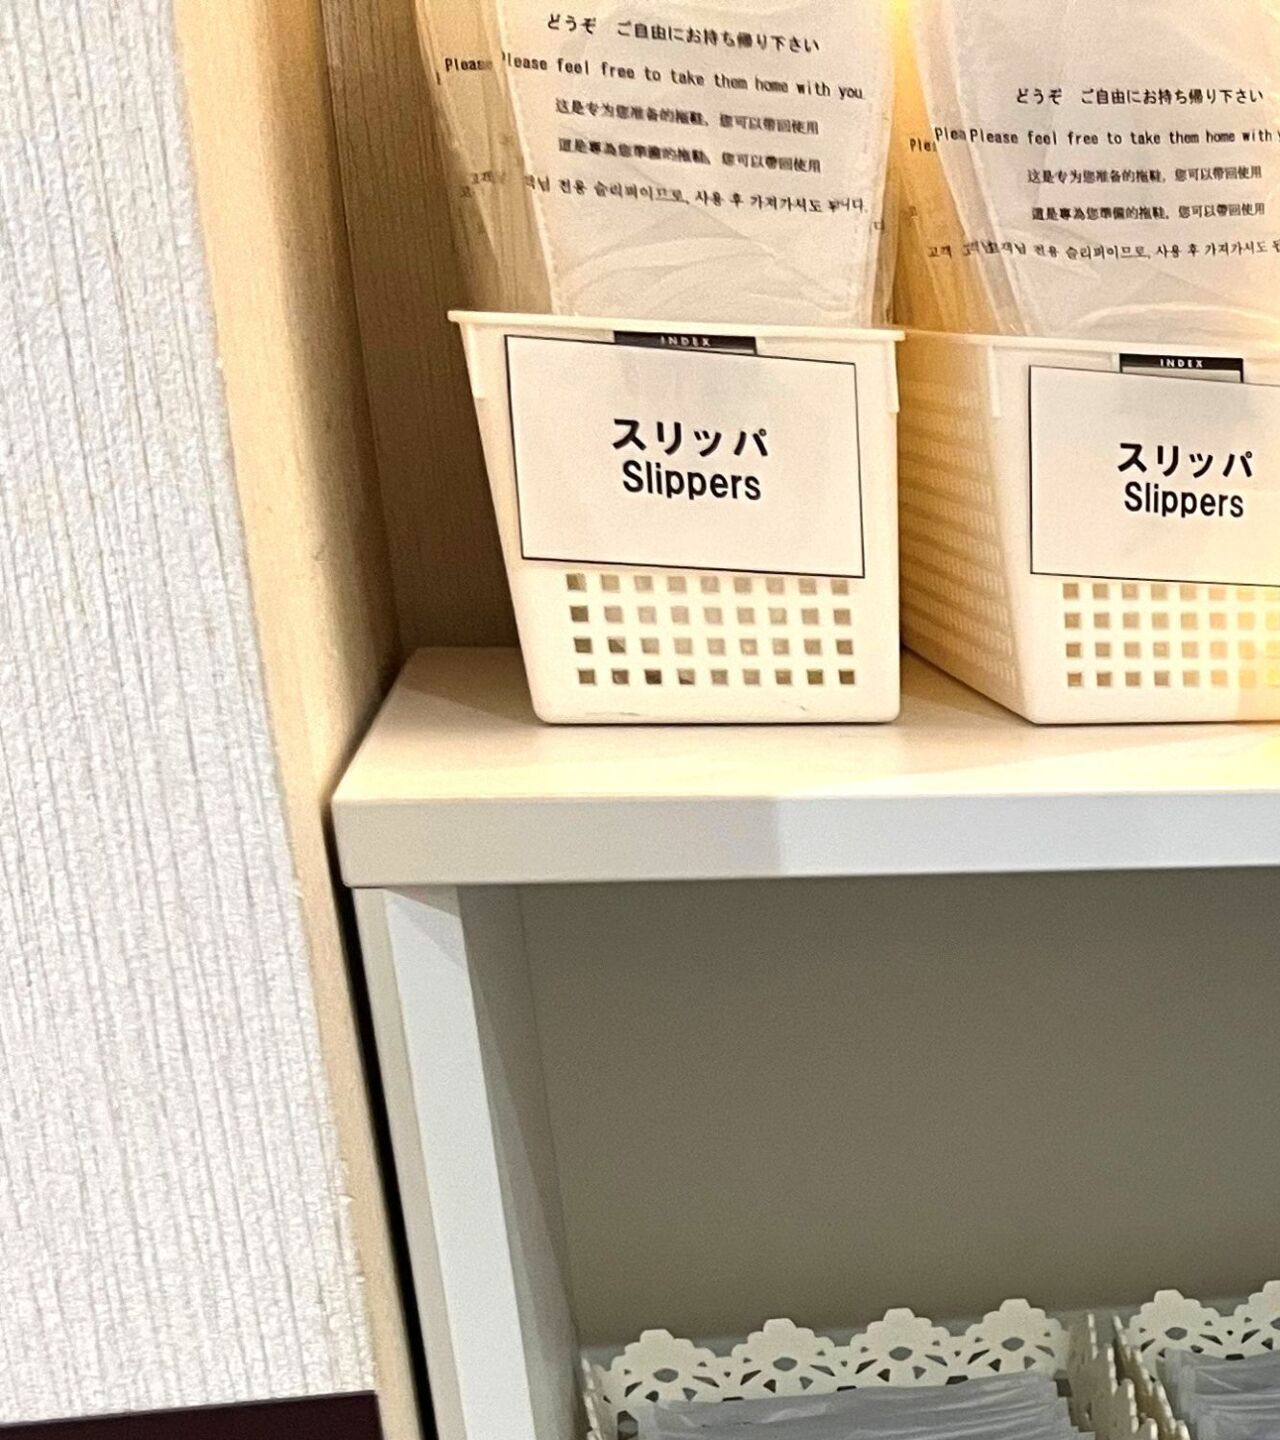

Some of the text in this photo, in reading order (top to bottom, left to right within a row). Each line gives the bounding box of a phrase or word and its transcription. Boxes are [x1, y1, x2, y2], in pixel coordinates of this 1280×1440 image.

[548, 13, 596, 34] どうぞ
[558, 58, 589, 74] feel
[602, 61, 635, 79] free
[646, 66, 660, 81] to
[671, 69, 704, 86] take
[715, 74, 748, 90] them
[755, 75, 788, 93] home
[797, 81, 830, 97] with
[839, 87, 863, 99] you
[1017, 88, 1263, 105] どうぞ ご自由にお持ち帰り下さい
[970, 128, 1018, 144] Please
[1028, 131, 1056, 145] feel
[1068, 132, 1098, 145] free
[1107, 132, 1122, 145] to
[1131, 131, 1160, 145] take
[1170, 131, 1199, 144] them
[1206, 131, 1235, 143] home
[1243, 129, 1272, 141] with
[661, 336, 711, 347] INDEX
[1160, 358, 1203, 368] INDEX
[613, 418, 768, 458] スリッパ
[1118, 442, 1252, 479] スリッパ
[623, 460, 761, 500] Slippers
[1124, 481, 1243, 518] Slippers
